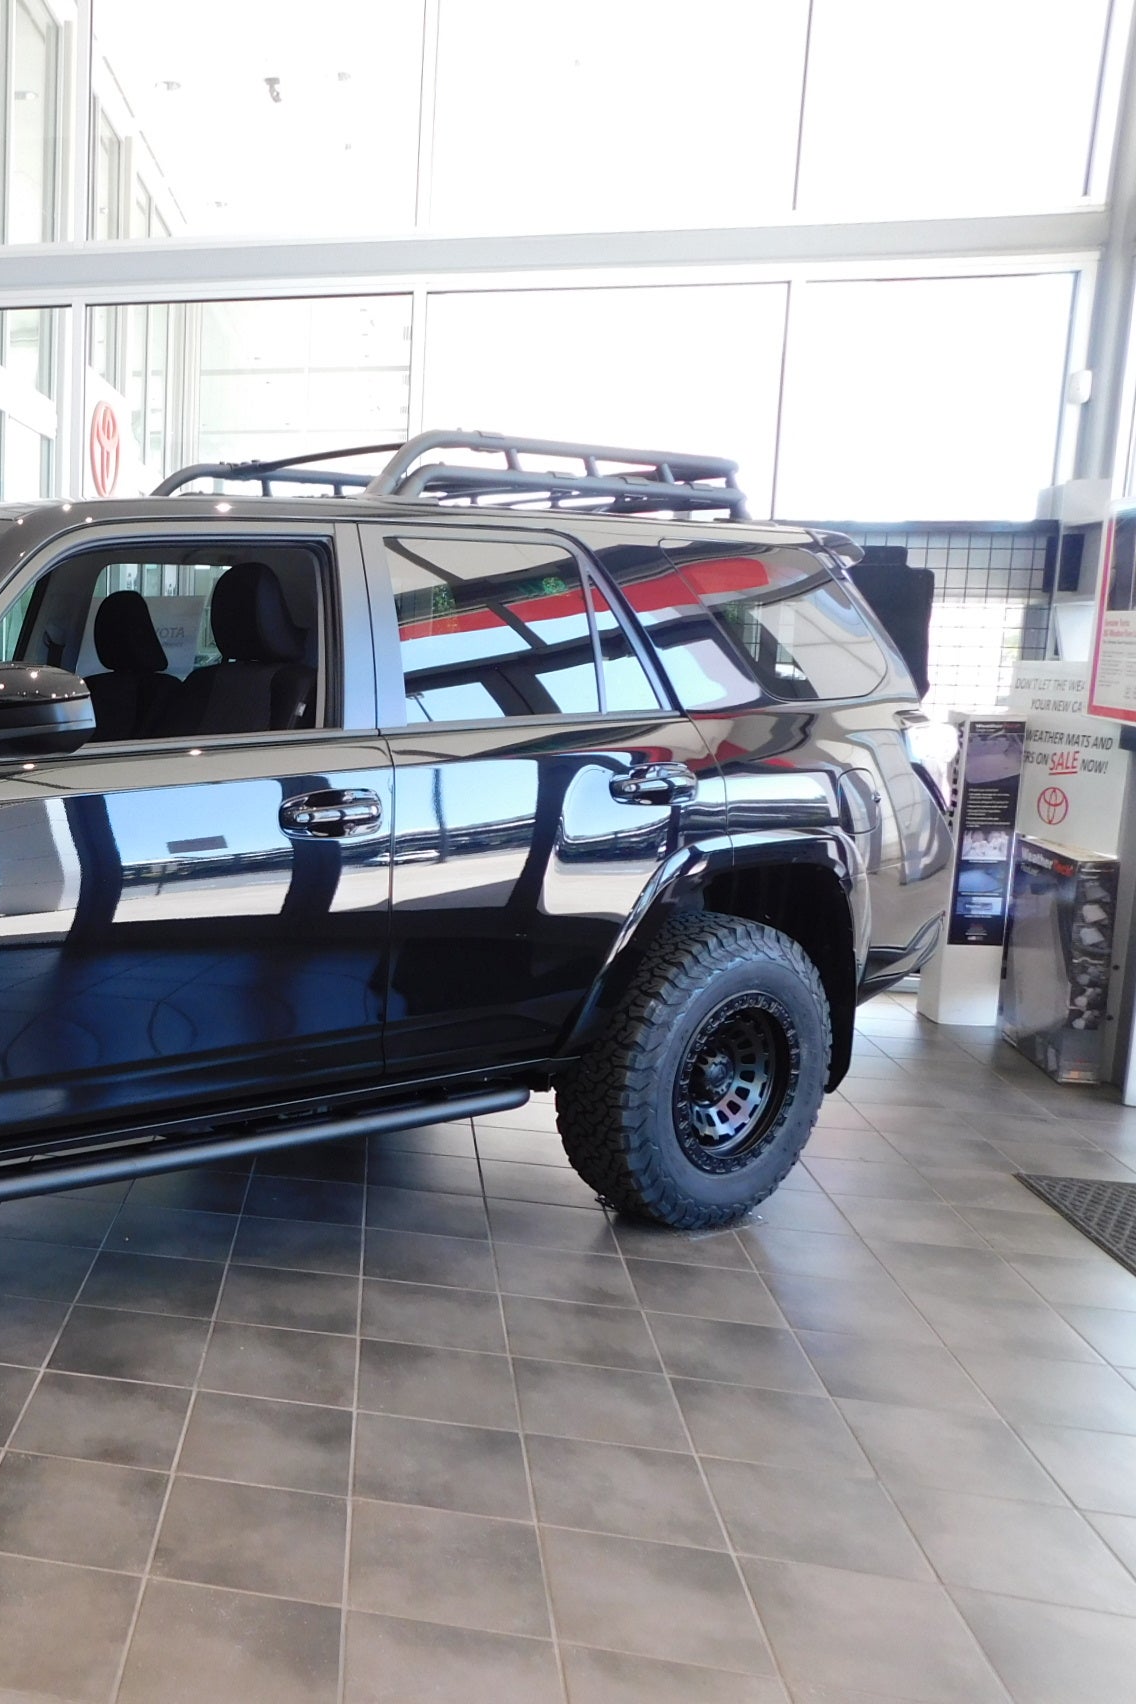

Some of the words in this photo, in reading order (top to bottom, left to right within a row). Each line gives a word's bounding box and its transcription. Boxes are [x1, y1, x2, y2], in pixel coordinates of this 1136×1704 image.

[1015, 678, 1038, 690] DON'T
[1038, 679, 1051, 690] LET
[1054, 679, 1068, 692] THE
[1031, 698, 1052, 711] YOUR
[1052, 700, 1070, 712] NEW
[1065, 732, 1092, 748] MATS
[1091, 736, 1114, 750] AND
[1035, 752, 1050, 766] ON
[1048, 751, 1080, 771] SALE
[1080, 758, 1109, 775] NOW!
